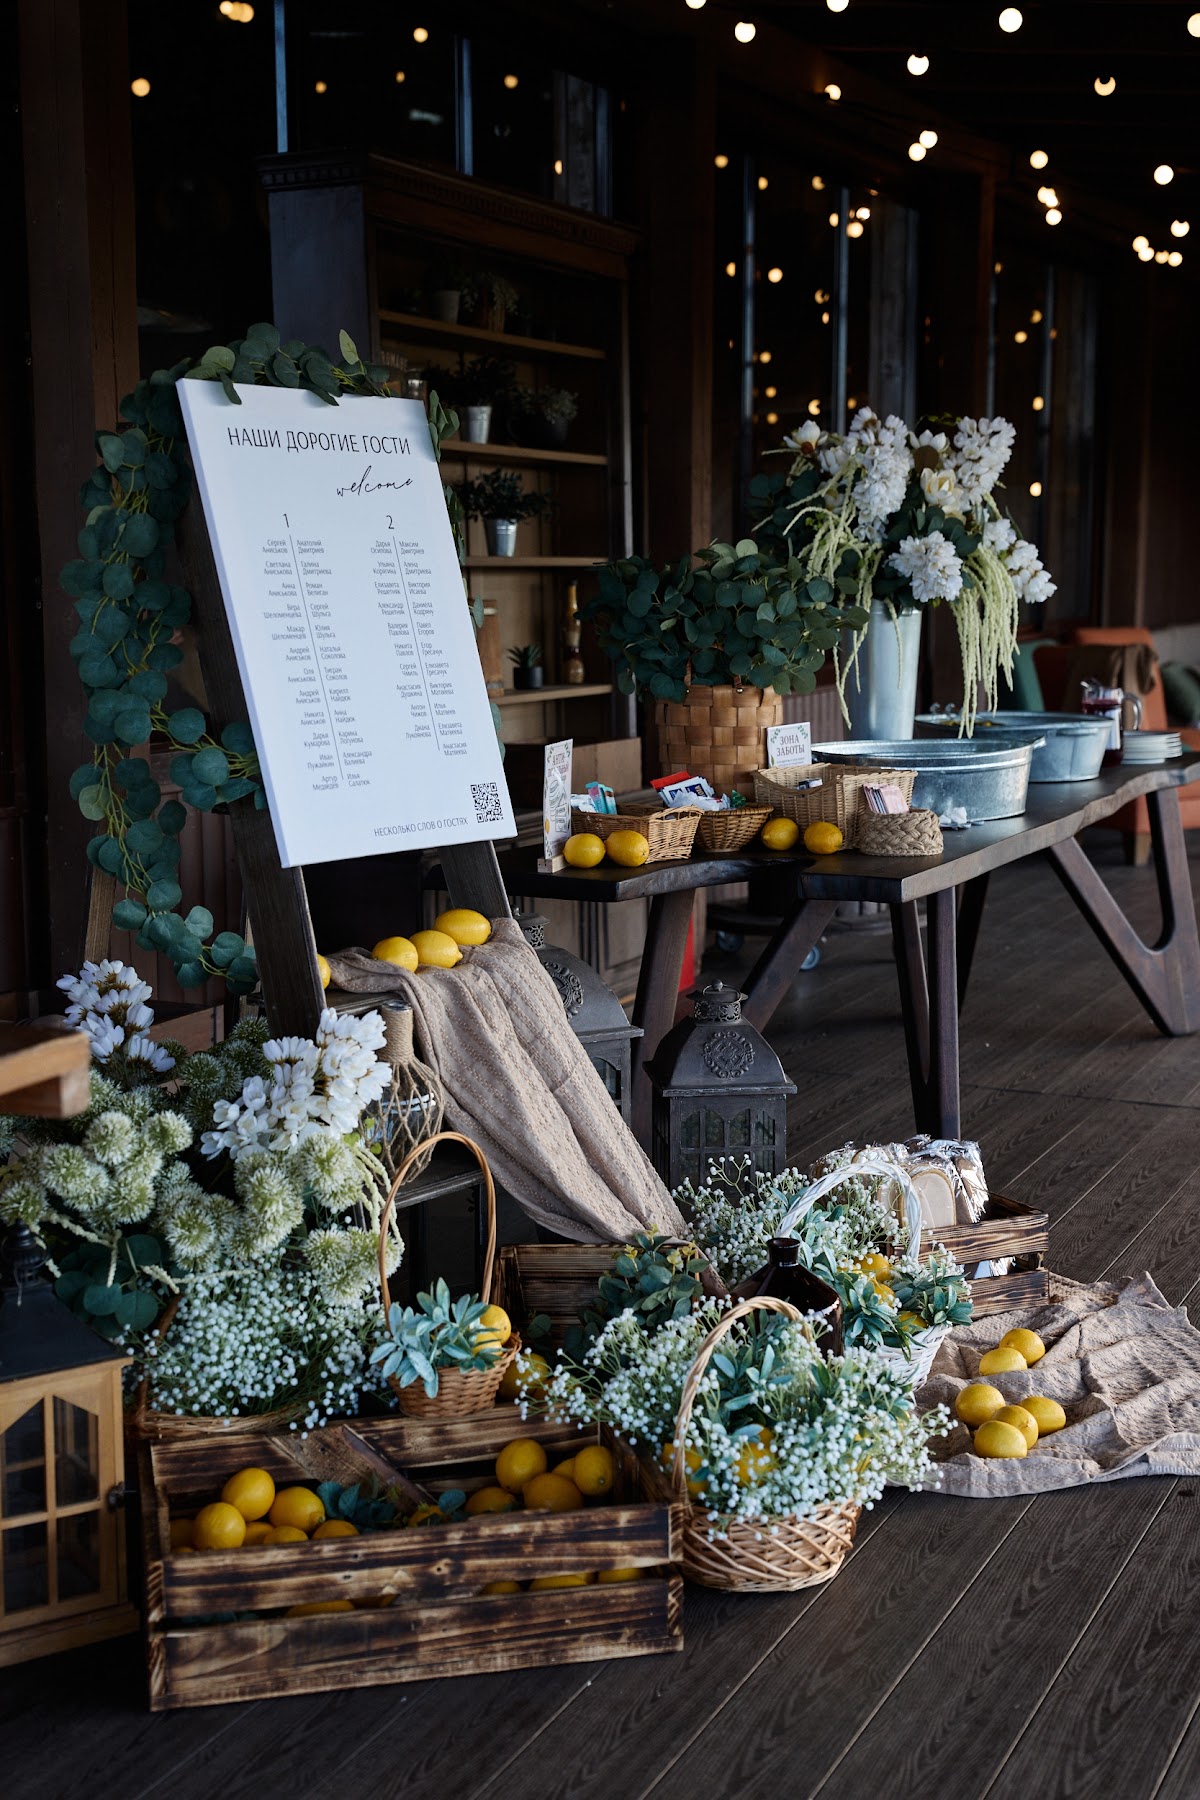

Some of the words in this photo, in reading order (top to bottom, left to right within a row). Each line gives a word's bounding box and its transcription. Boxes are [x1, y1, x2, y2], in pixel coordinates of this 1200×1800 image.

[228, 427, 282, 448] НАШИ
[286, 431, 359, 454] ДОРОГИЕ
[363, 435, 411, 455] ГОСТИ
[337, 465, 413, 498] welcome
[283, 513, 289, 528] 1
[386, 515, 395, 529] 2
[780, 735, 799, 745] ЗОНА
[777, 745, 804, 756] ЗАБОТЫ
[374, 824, 416, 837] НЕСКОЛЬКО
[417, 821, 436, 831] СЛОВ
[437, 819, 443, 829] О
[444, 817, 469, 827] ГОСТЯХ
